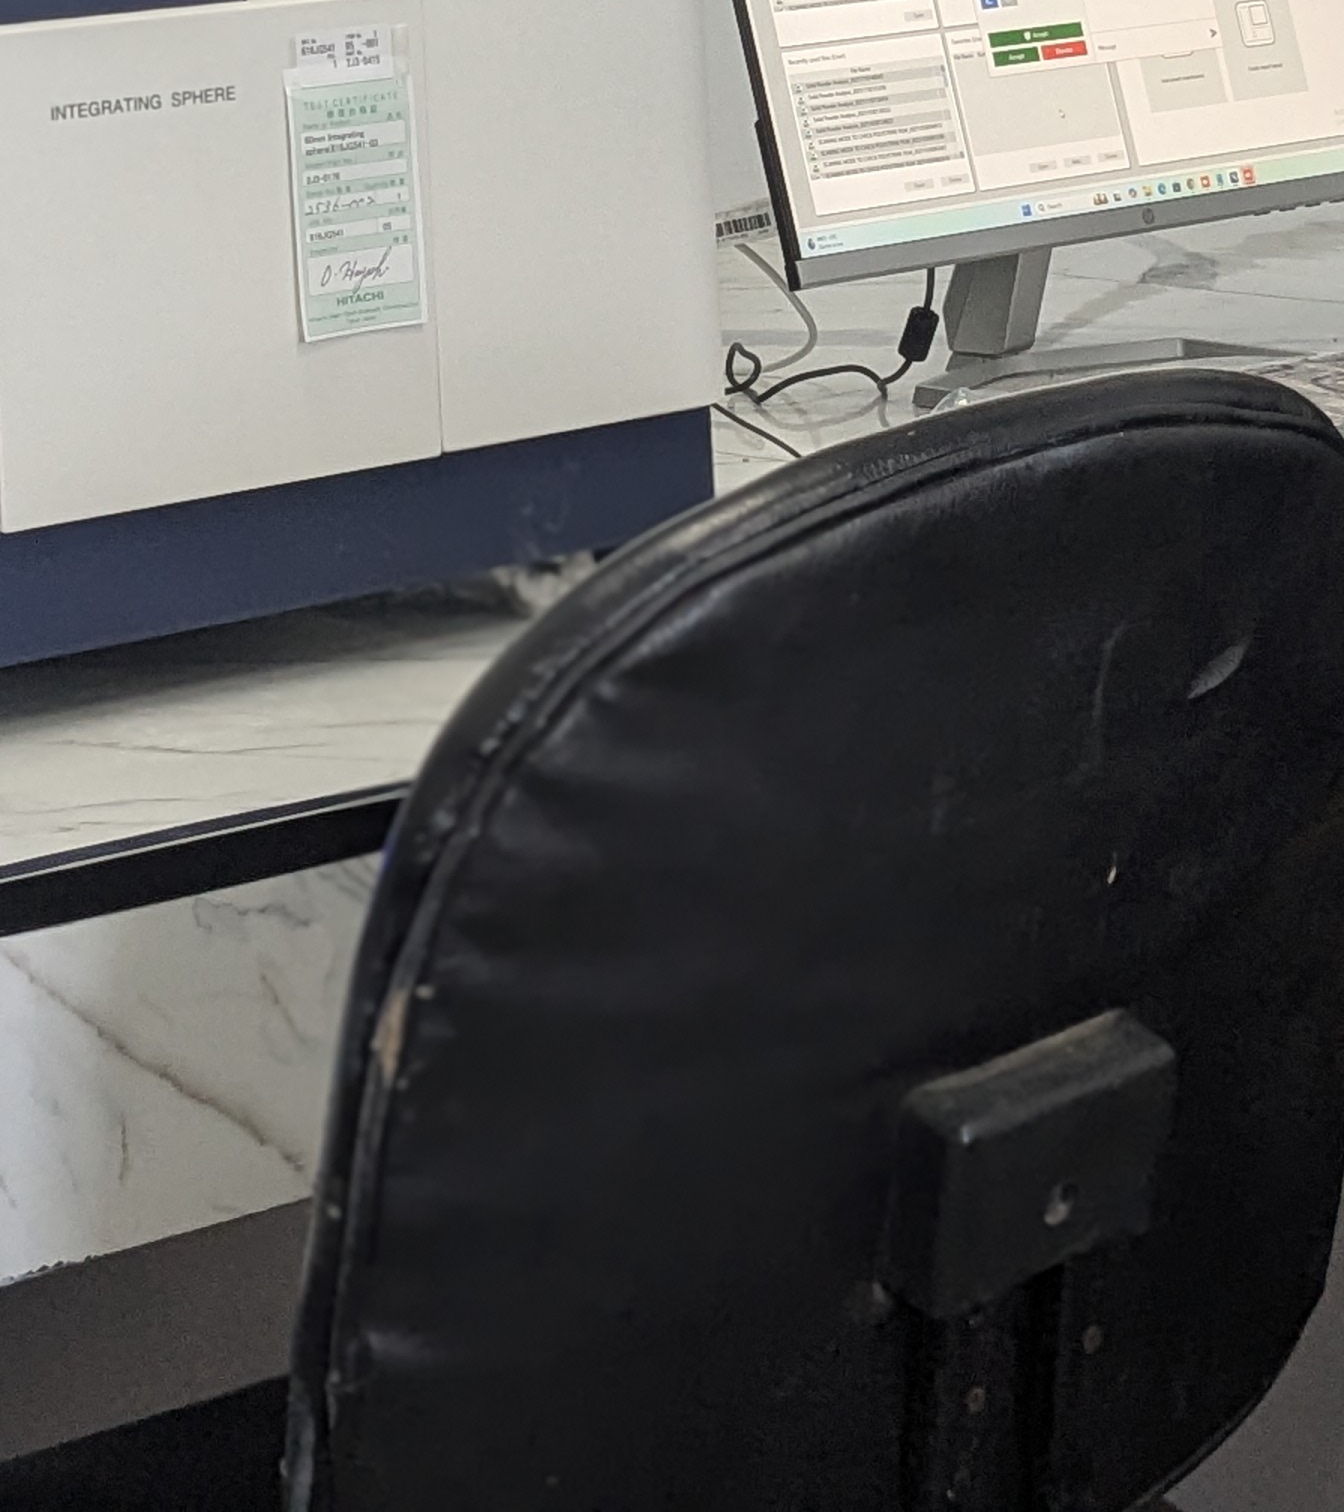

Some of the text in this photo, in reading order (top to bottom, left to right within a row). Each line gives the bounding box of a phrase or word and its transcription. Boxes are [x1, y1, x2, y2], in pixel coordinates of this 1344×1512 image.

[50, 86, 237, 121] INTEGRATING SPHERE
[337, 291, 385, 307] HITACHI
